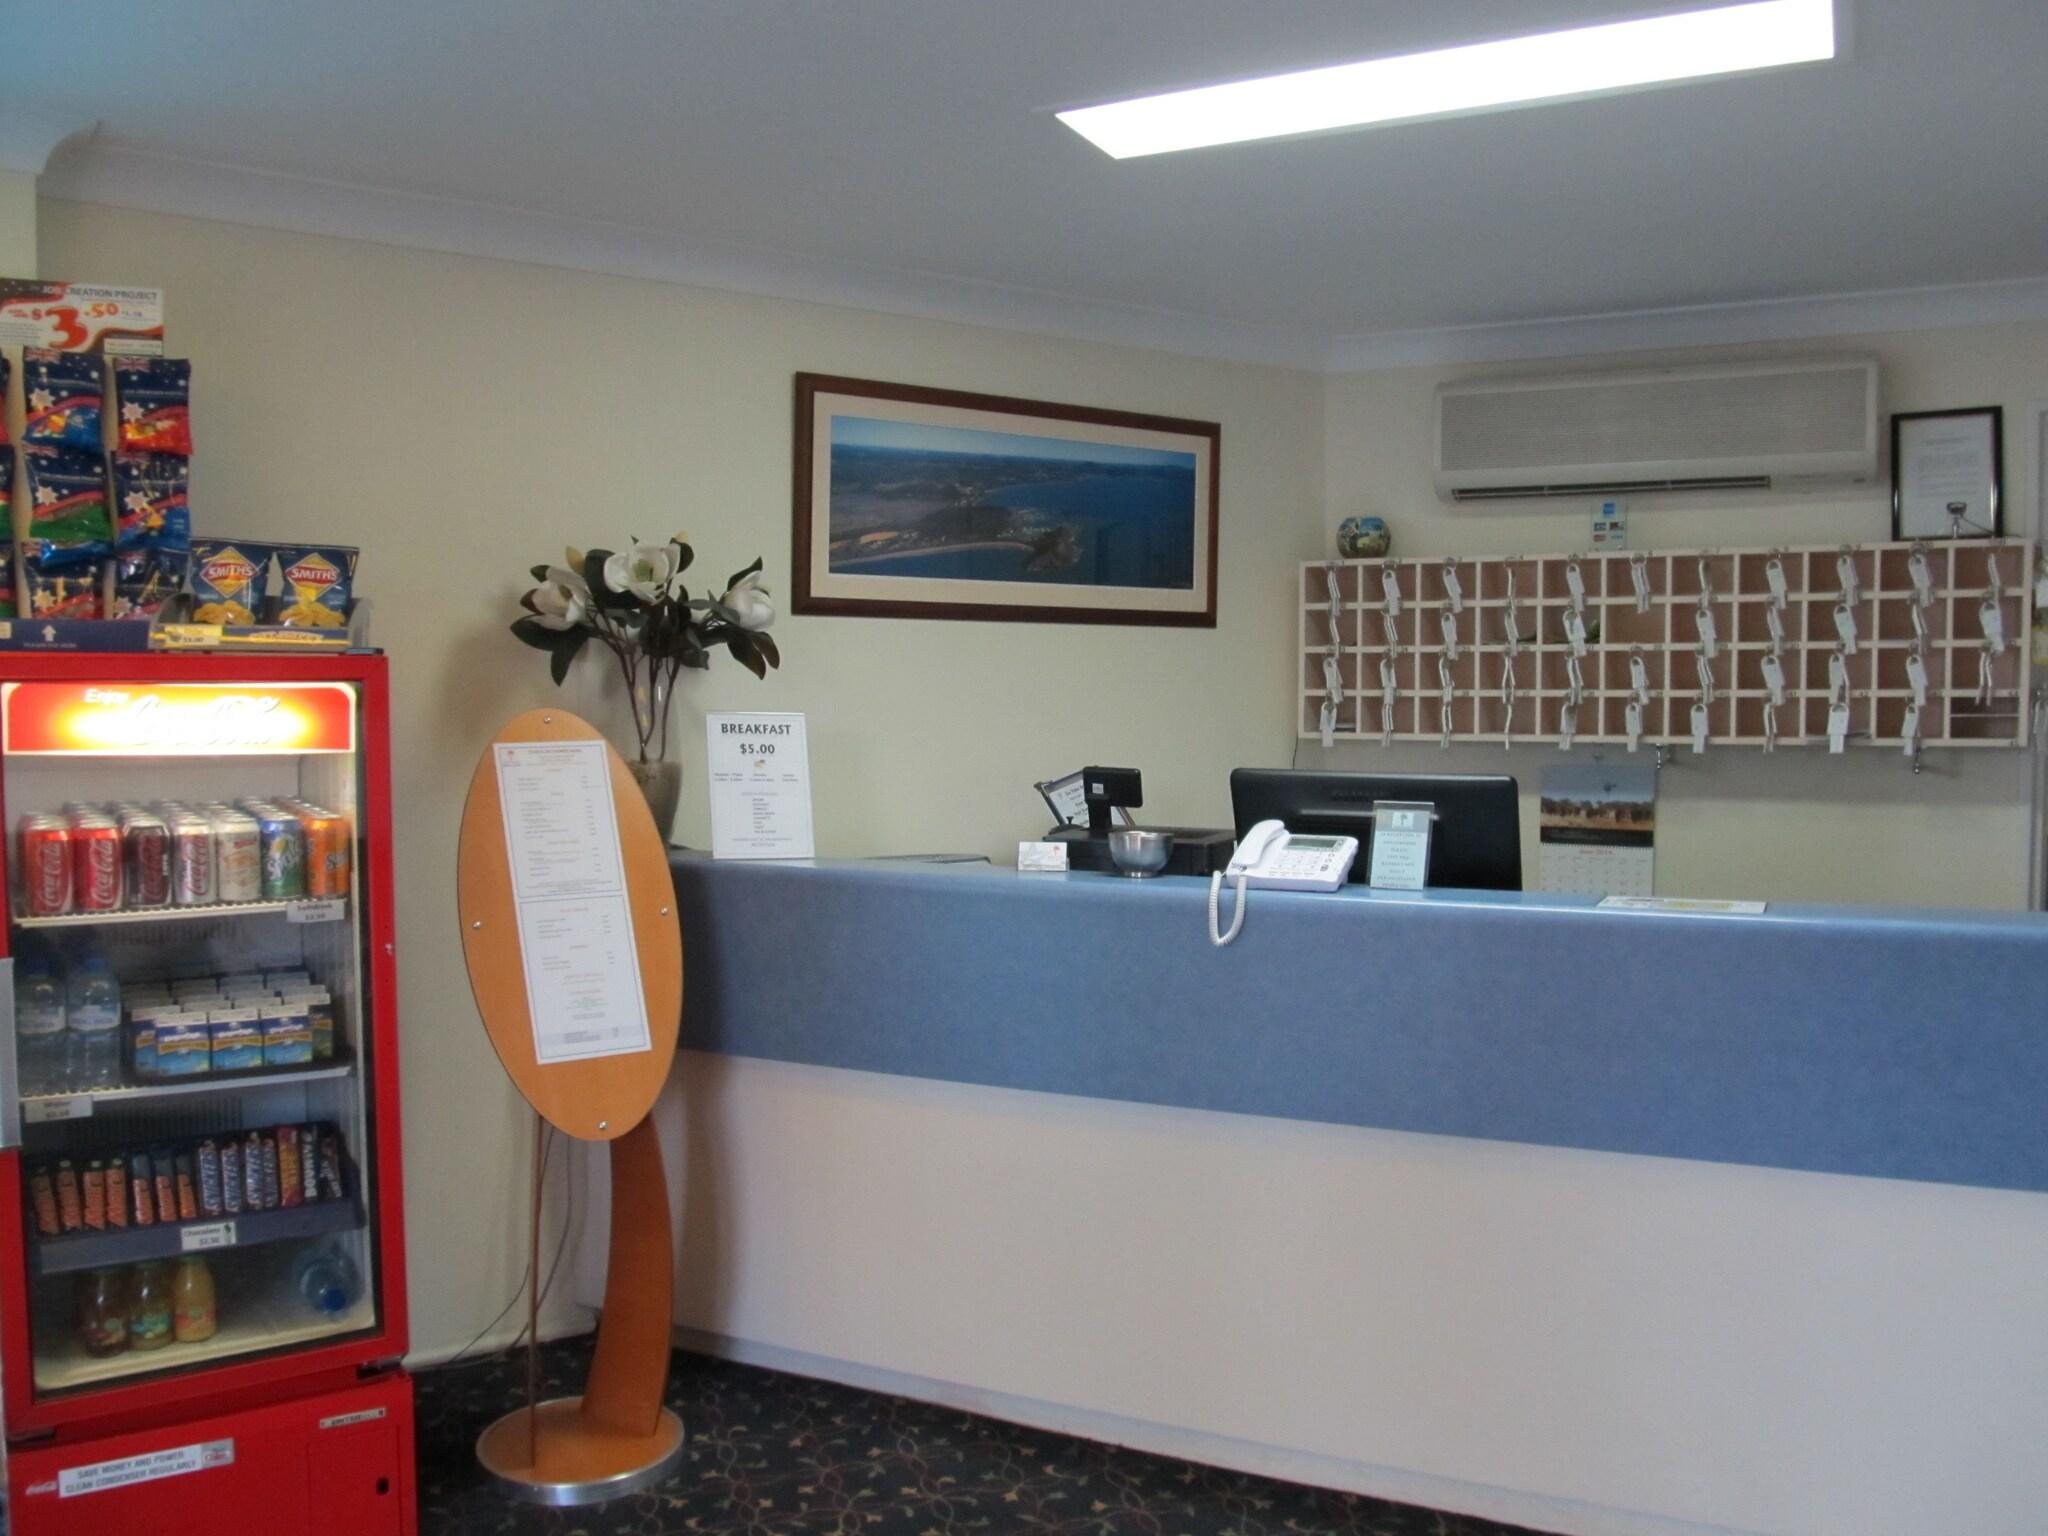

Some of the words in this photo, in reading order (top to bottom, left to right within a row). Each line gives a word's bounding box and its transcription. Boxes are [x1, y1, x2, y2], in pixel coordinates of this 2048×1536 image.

[65, 286, 113, 299] CREATION
[114, 290, 157, 299] PROJECT
[721, 723, 792, 735] BREAKFAST
[739, 743, 775, 755] $5.00
[303, 1132, 317, 1198] BOUNTY
